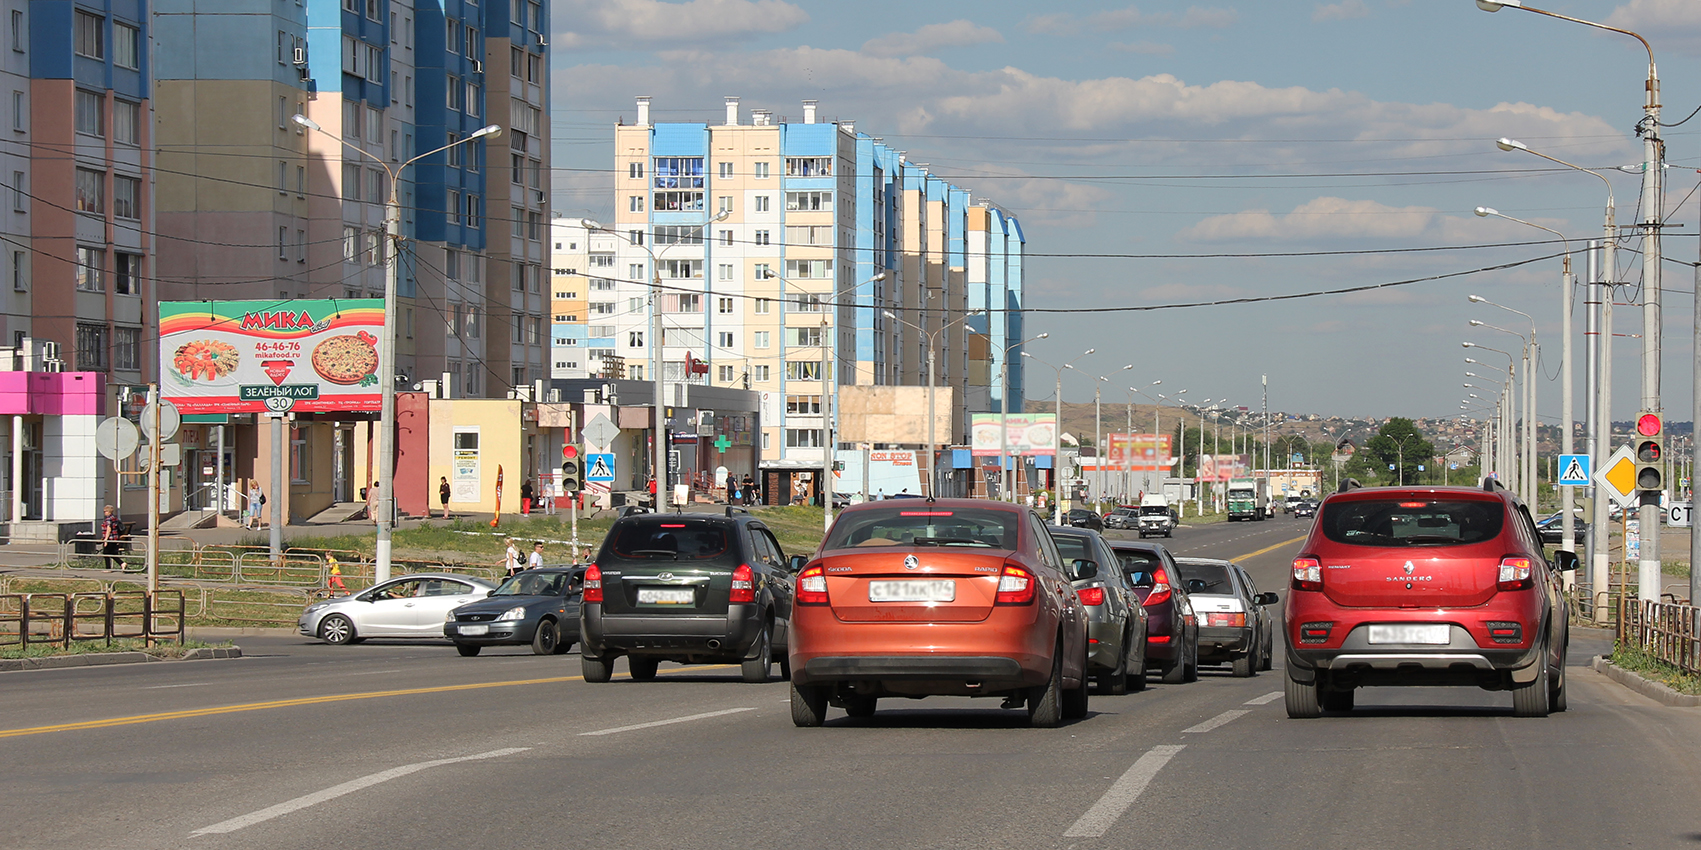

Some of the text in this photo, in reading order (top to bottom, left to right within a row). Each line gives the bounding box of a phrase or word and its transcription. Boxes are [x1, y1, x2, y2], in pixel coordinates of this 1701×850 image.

[240, 310, 315, 330] МИКА
[255, 342, 300, 351] 46-46-76
[246, 386, 314, 397] ЗЕЛЁНЫЙ ЛОГ
[272, 398, 288, 409] 30
[1671, 506, 1694, 522] СТ
